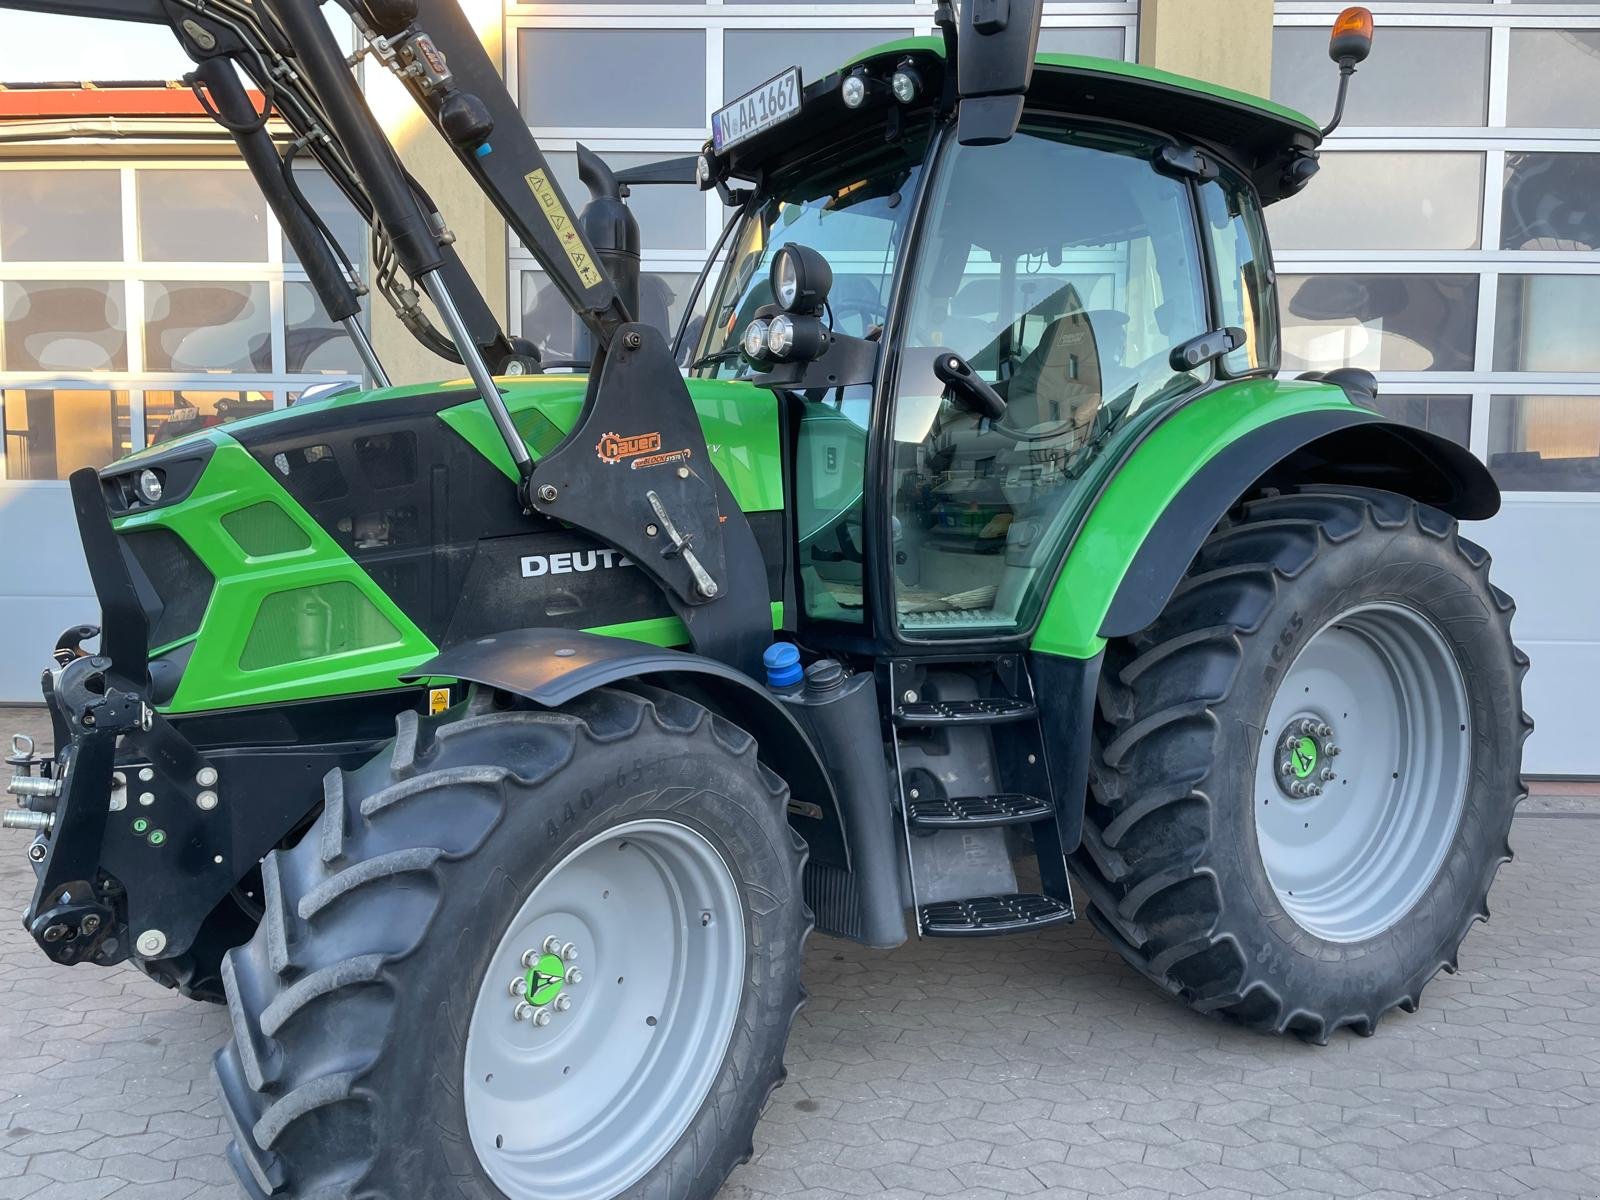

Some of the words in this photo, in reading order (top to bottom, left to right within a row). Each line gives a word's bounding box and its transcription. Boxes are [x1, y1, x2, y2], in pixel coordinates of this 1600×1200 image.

[720, 111, 732, 142] N
[739, 97, 757, 132] AA
[758, 75, 795, 122] 1667
[606, 436, 658, 457] hauer
